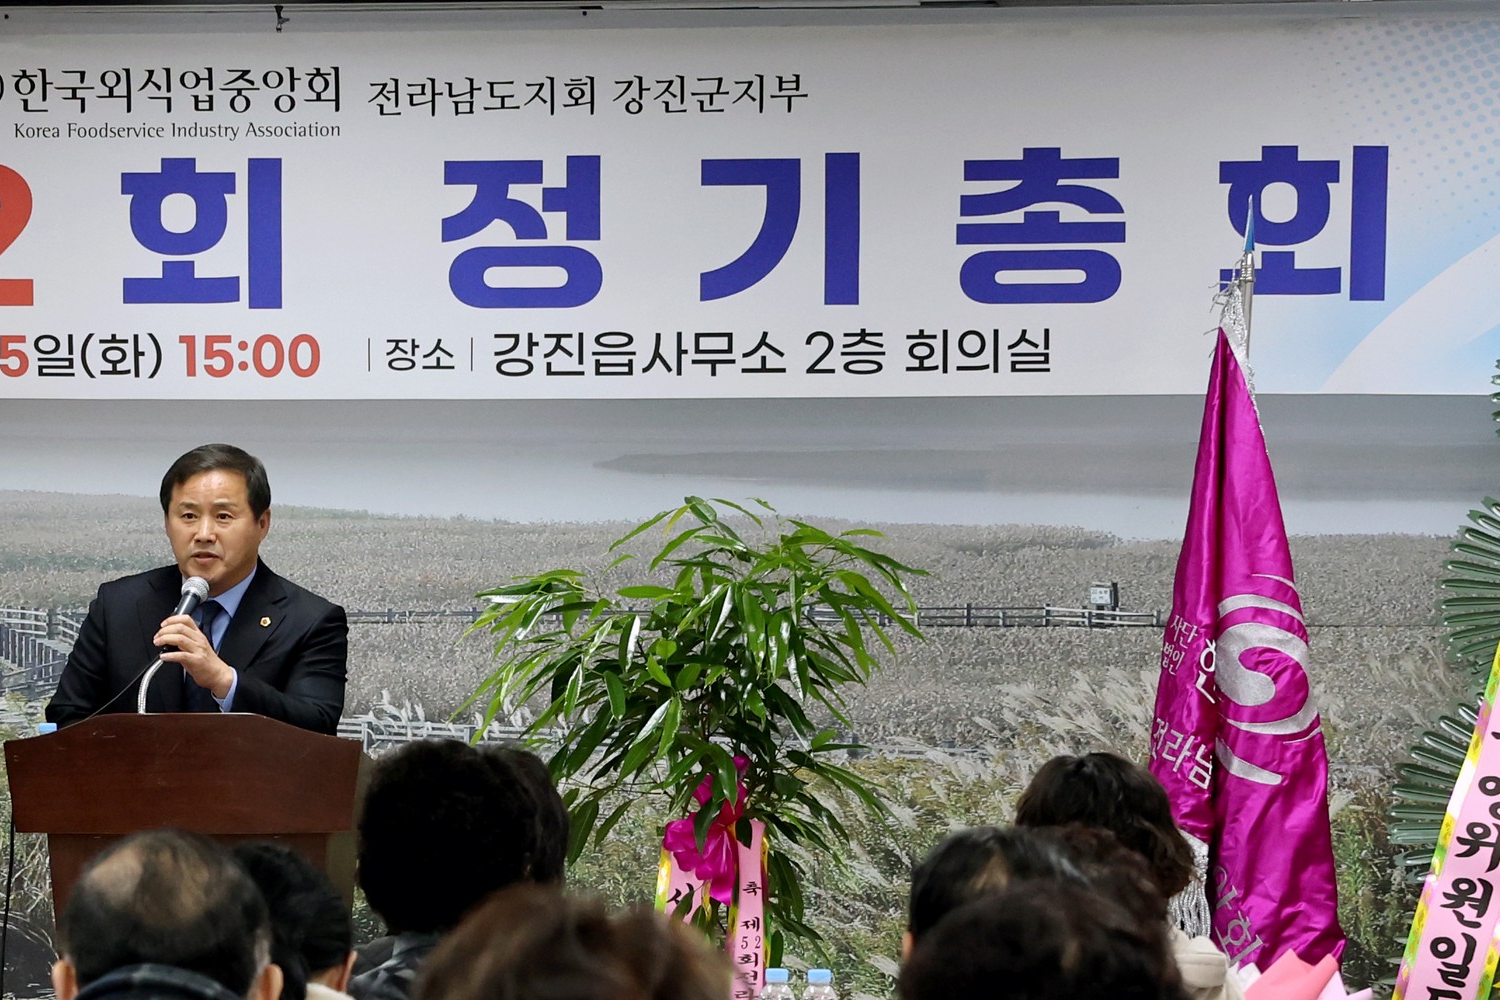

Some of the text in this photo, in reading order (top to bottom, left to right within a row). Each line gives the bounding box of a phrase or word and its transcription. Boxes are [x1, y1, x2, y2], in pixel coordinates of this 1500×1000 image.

[367, 75, 597, 117] 전라남도지회
[612, 73, 810, 116] 강진군지부
[14, 121, 341, 142] Korea Foodservice Industry Association
[0, 332, 163, 379] 5일(화)
[178, 333, 321, 378] 15:00
[386, 338, 455, 371] 장소
[492, 331, 787, 377] 강진읍사무소
[804, 328, 886, 375] 2층
[904, 328, 1052, 374] 회의실
